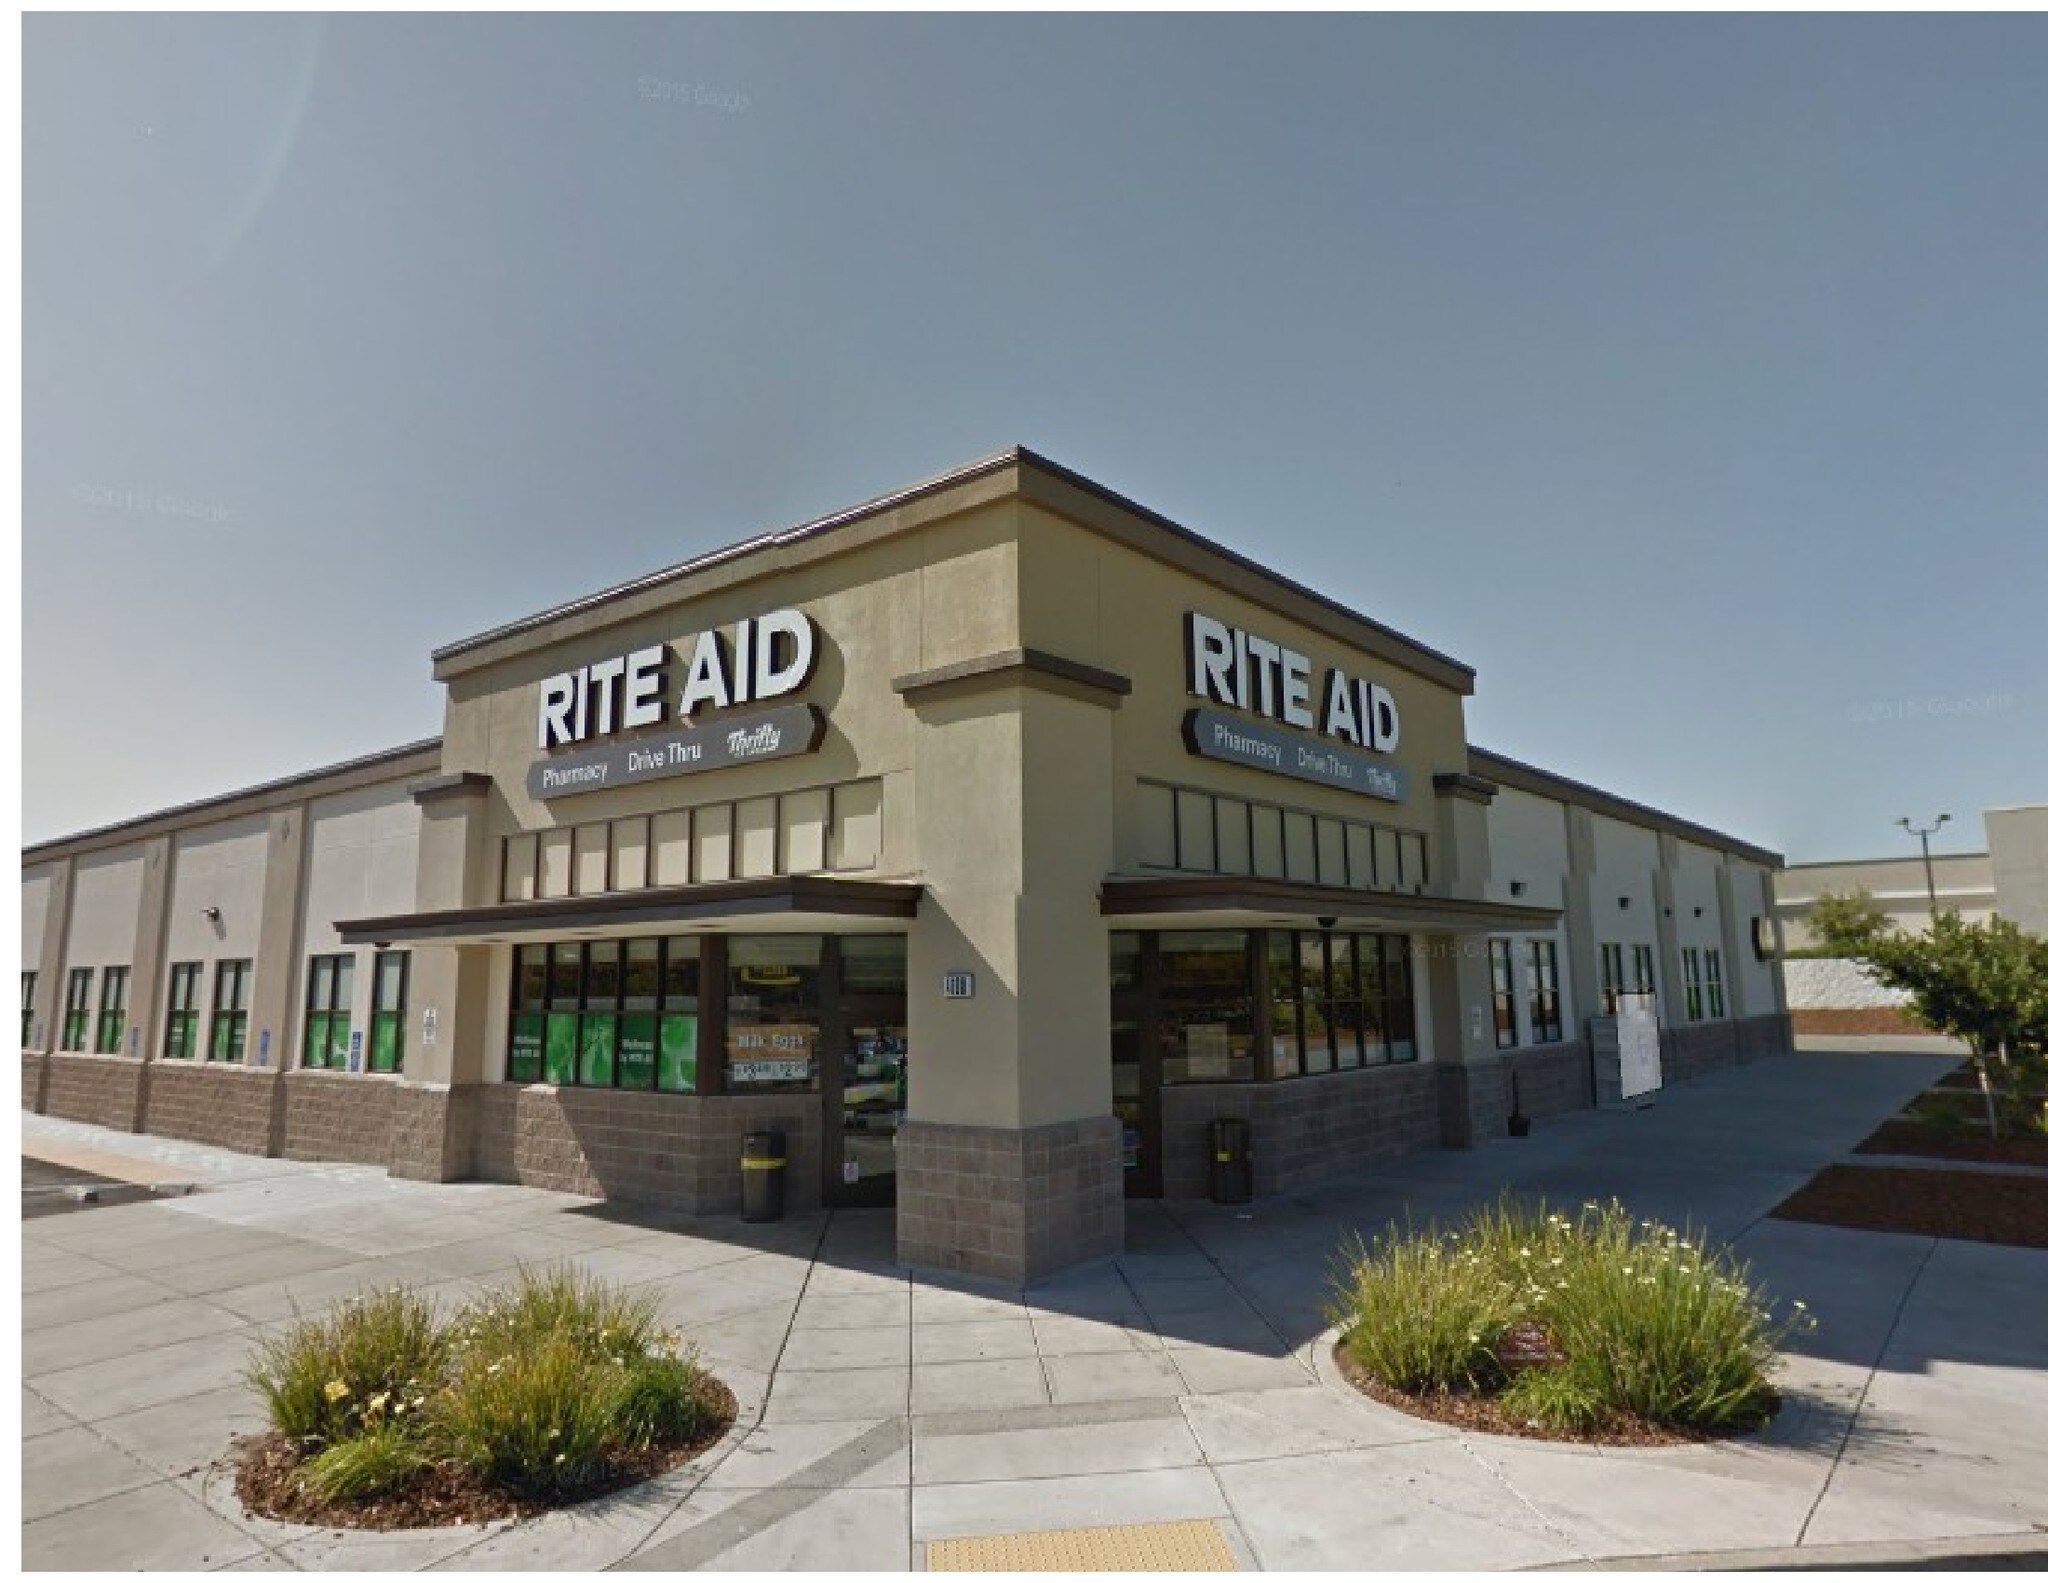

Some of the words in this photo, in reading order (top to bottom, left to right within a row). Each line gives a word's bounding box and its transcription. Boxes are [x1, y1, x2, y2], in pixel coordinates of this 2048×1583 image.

[538, 645, 665, 749] RITE
[678, 608, 816, 717] AID
[1190, 611, 1314, 730] RITE
[1325, 668, 1399, 754] AID
[542, 761, 608, 788] Pharmacy
[628, 748, 664, 772] Drive
[667, 741, 702, 764] Thru
[1213, 723, 1282, 766] Pharmacy
[1297, 746, 1325, 773] Drive
[1326, 753, 1353, 779] Thru
